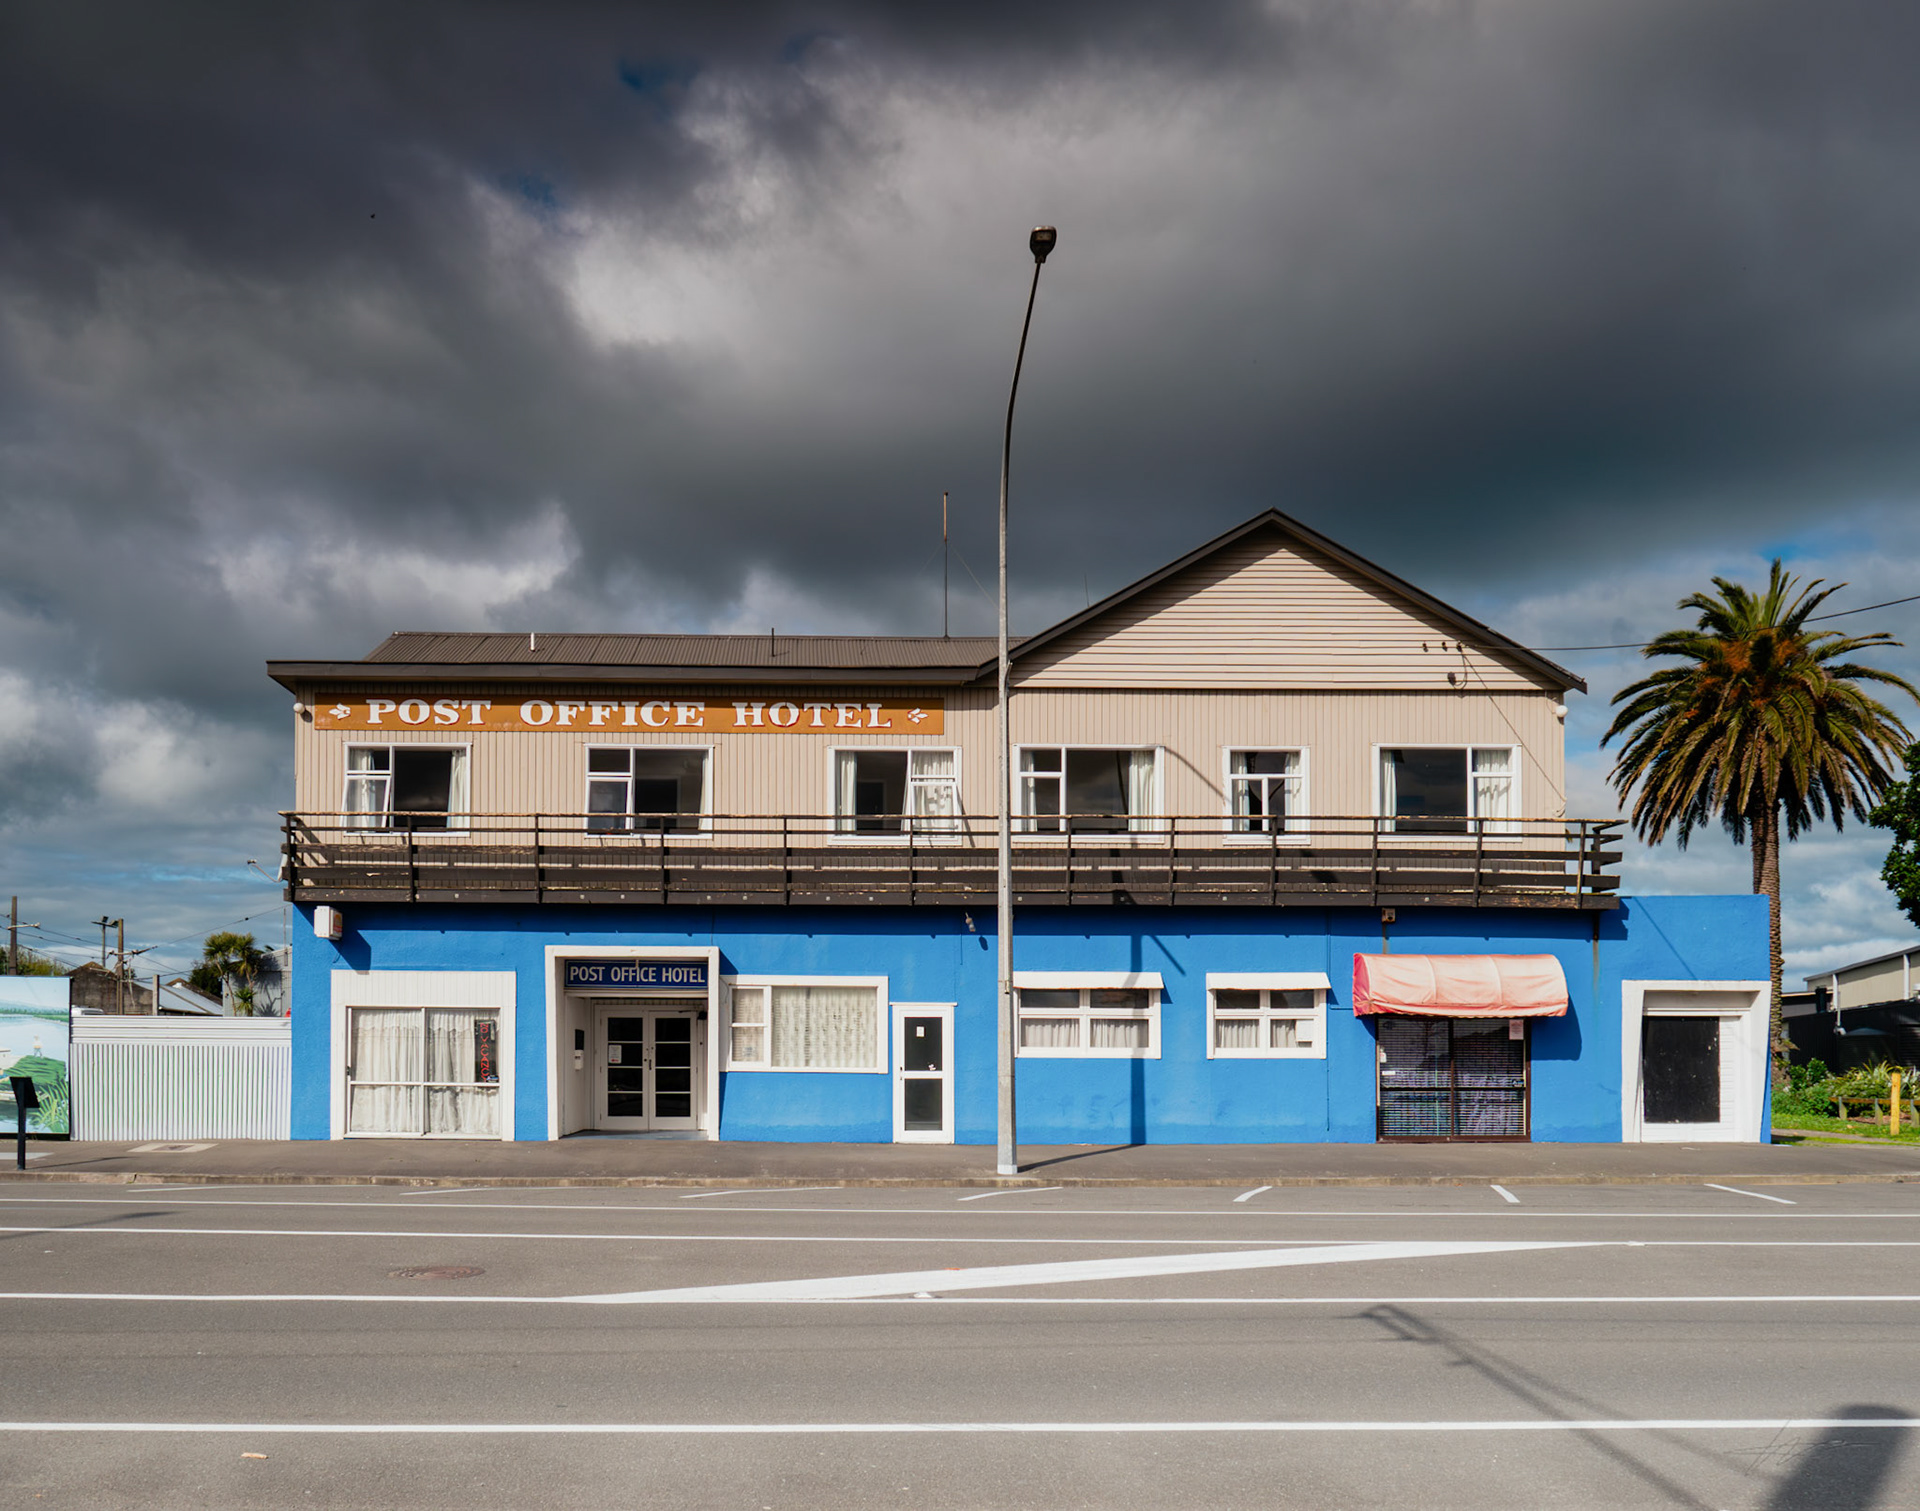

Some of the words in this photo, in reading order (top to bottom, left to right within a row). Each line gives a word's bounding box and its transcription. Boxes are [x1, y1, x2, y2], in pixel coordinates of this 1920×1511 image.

[365, 699, 491, 725] POST
[519, 700, 705, 727] OFFICE
[731, 701, 892, 728] HOTEL
[570, 966, 605, 981] POST
[610, 966, 657, 982] OFFICE
[661, 967, 705, 983] HOTEL
[480, 1022, 489, 1033] NO
